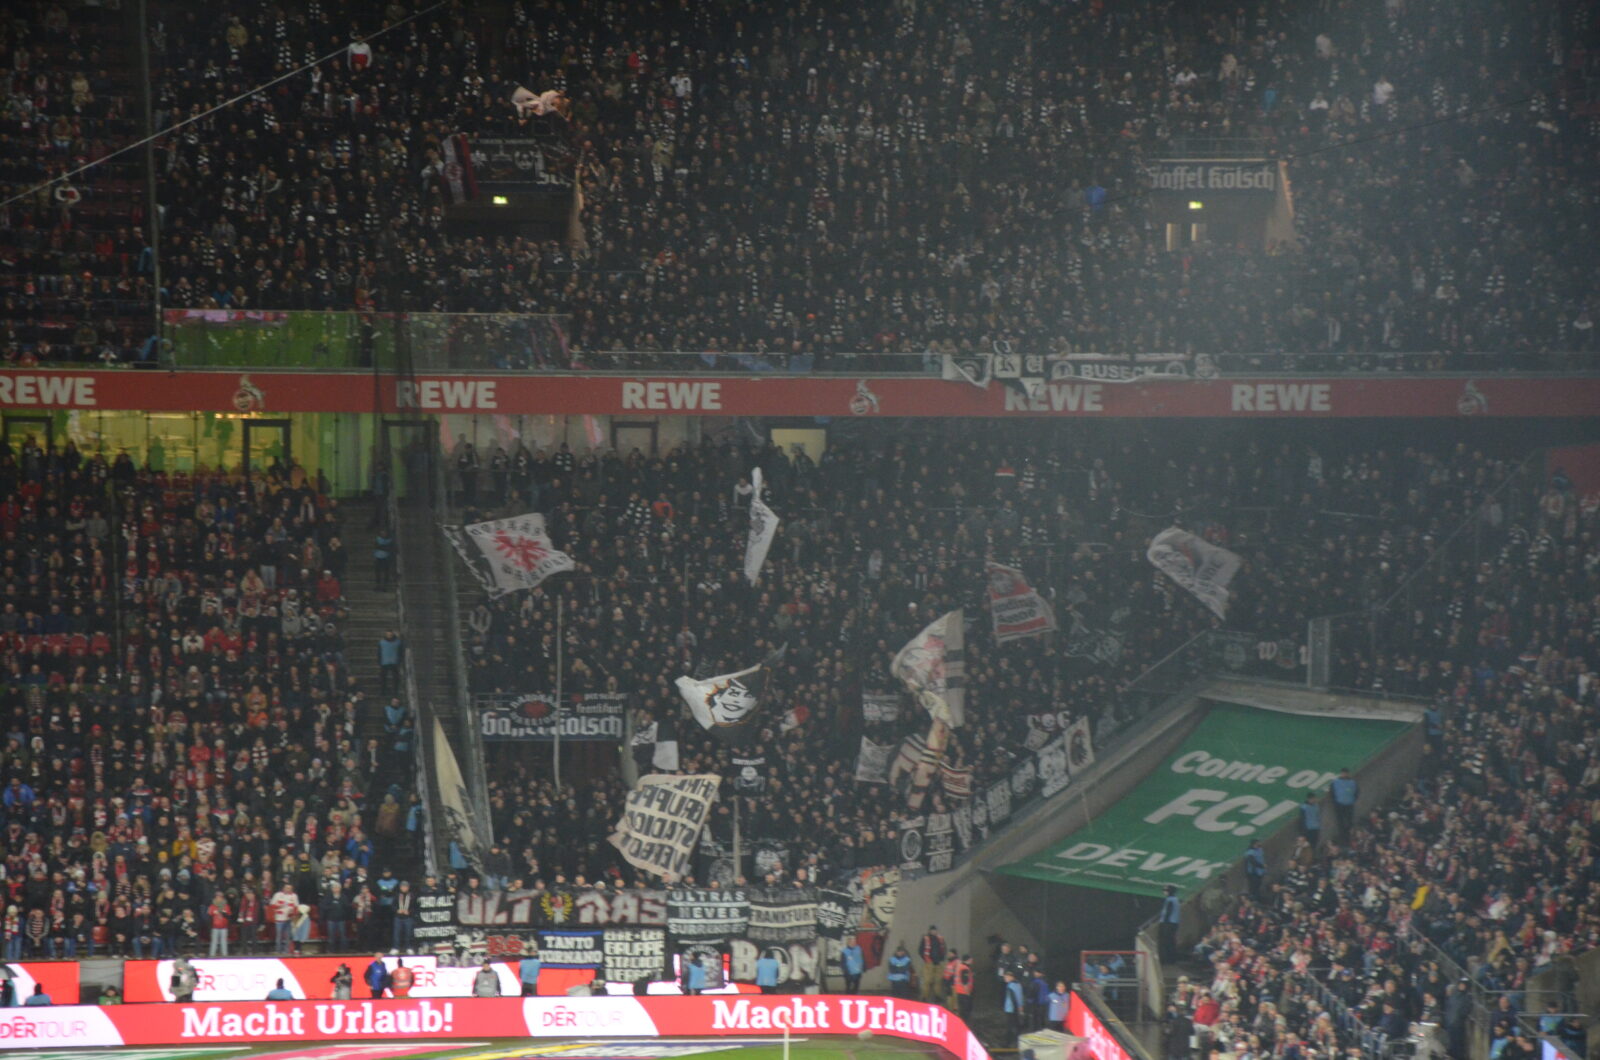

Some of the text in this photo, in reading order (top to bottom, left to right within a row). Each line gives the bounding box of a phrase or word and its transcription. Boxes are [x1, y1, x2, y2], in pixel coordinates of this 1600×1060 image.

[396, 381, 497, 409] REWE
[622, 382, 721, 410] REWE
[1231, 384, 1331, 411] REWE
[1171, 750, 1288, 784] Come
[1143, 788, 1299, 836] FC!
[1056, 842, 1226, 879] DEVK
[671, 890, 746, 902] ULTRAS
[680, 906, 740, 919] NEVER
[543, 935, 594, 950] TANTO
[0, 1015, 87, 1039] DERTOUR
[181, 1004, 305, 1037] Macht
[315, 1002, 453, 1034] Urlaub!
[543, 1005, 623, 1027] DERTOUR
[712, 998, 830, 1028] Macht
